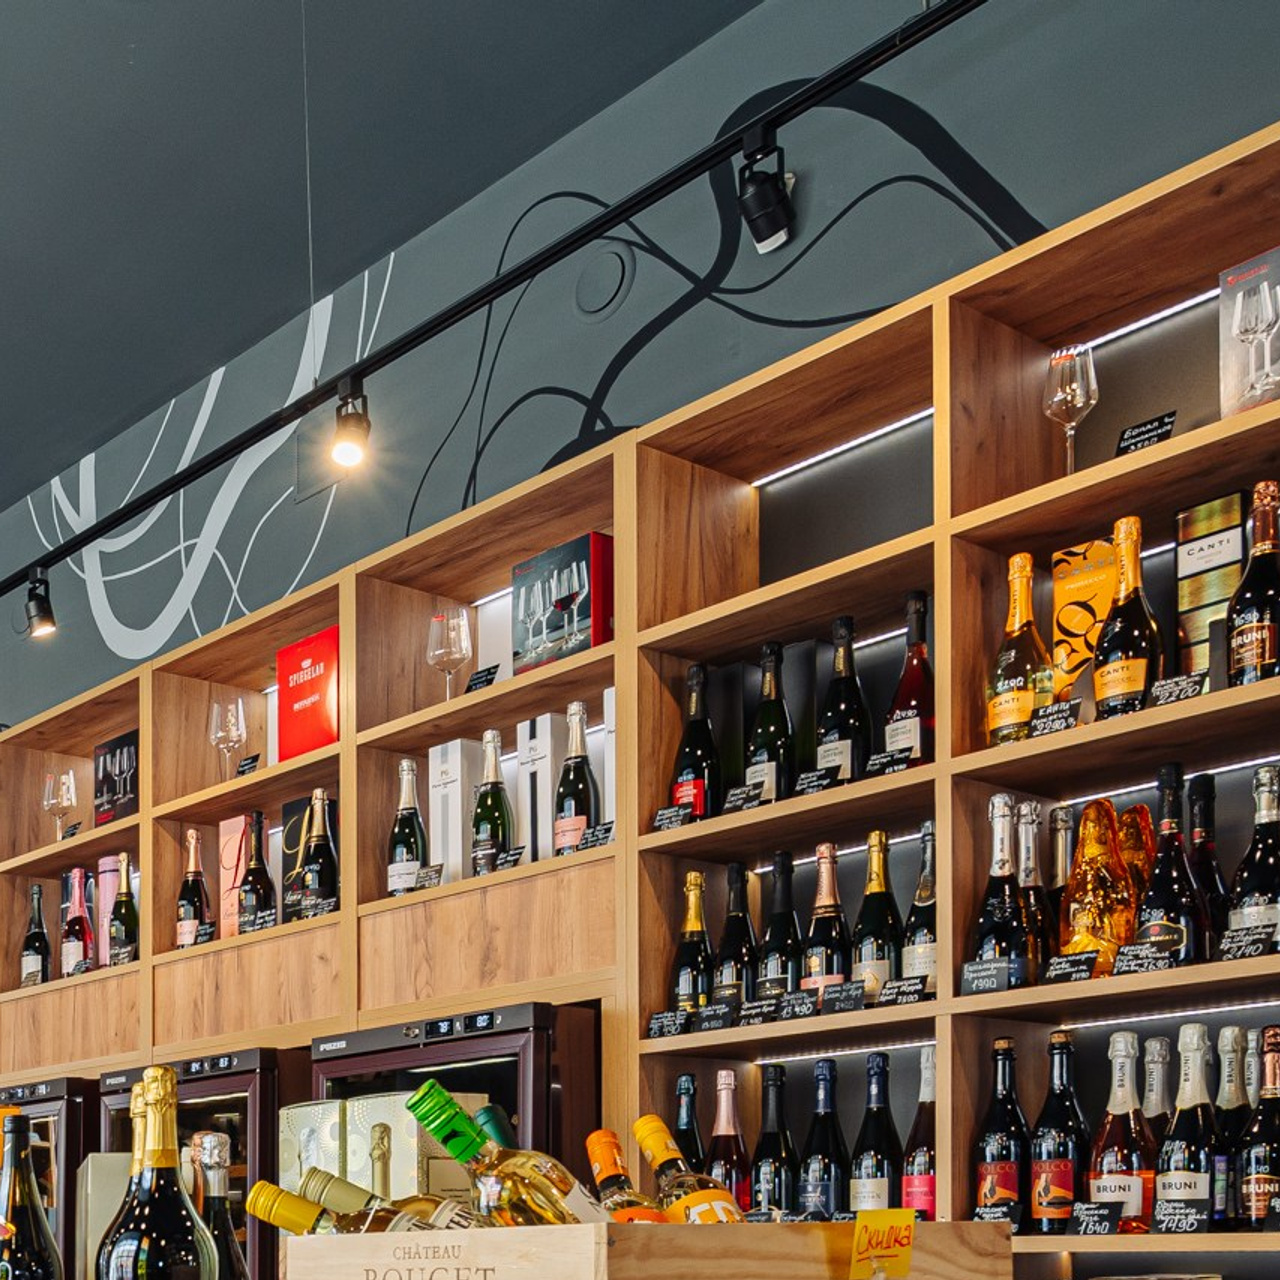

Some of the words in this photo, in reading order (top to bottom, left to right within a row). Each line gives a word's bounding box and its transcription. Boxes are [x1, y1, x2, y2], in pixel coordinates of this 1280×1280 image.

[1187, 538, 1231, 556] CANTI
[1231, 629, 1268, 648] BRUNI
[288, 661, 324, 687] SPIEGELAU
[1100, 665, 1131, 678] CANTI
[992, 697, 1020, 708] CANTI
[1156, 684, 1200, 705] 2200
[1222, 942, 1264, 960] 2140
[971, 977, 997, 991] 1990
[1117, 1061, 1126, 1088] BRUNI
[1226, 1057, 1234, 1084] BRUNI
[1033, 1161, 1071, 1172] SOLCO
[1096, 1184, 1132, 1194] BRUNI
[1161, 1181, 1198, 1191] BRUNI
[1241, 1183, 1280, 1194] BRUNI
[1078, 1222, 1110, 1235] 1640
[1158, 1216, 1198, 1232] 1490
[857, 1224, 912, 1255] Скидка
[392, 1243, 462, 1261] CHÂTEAU
